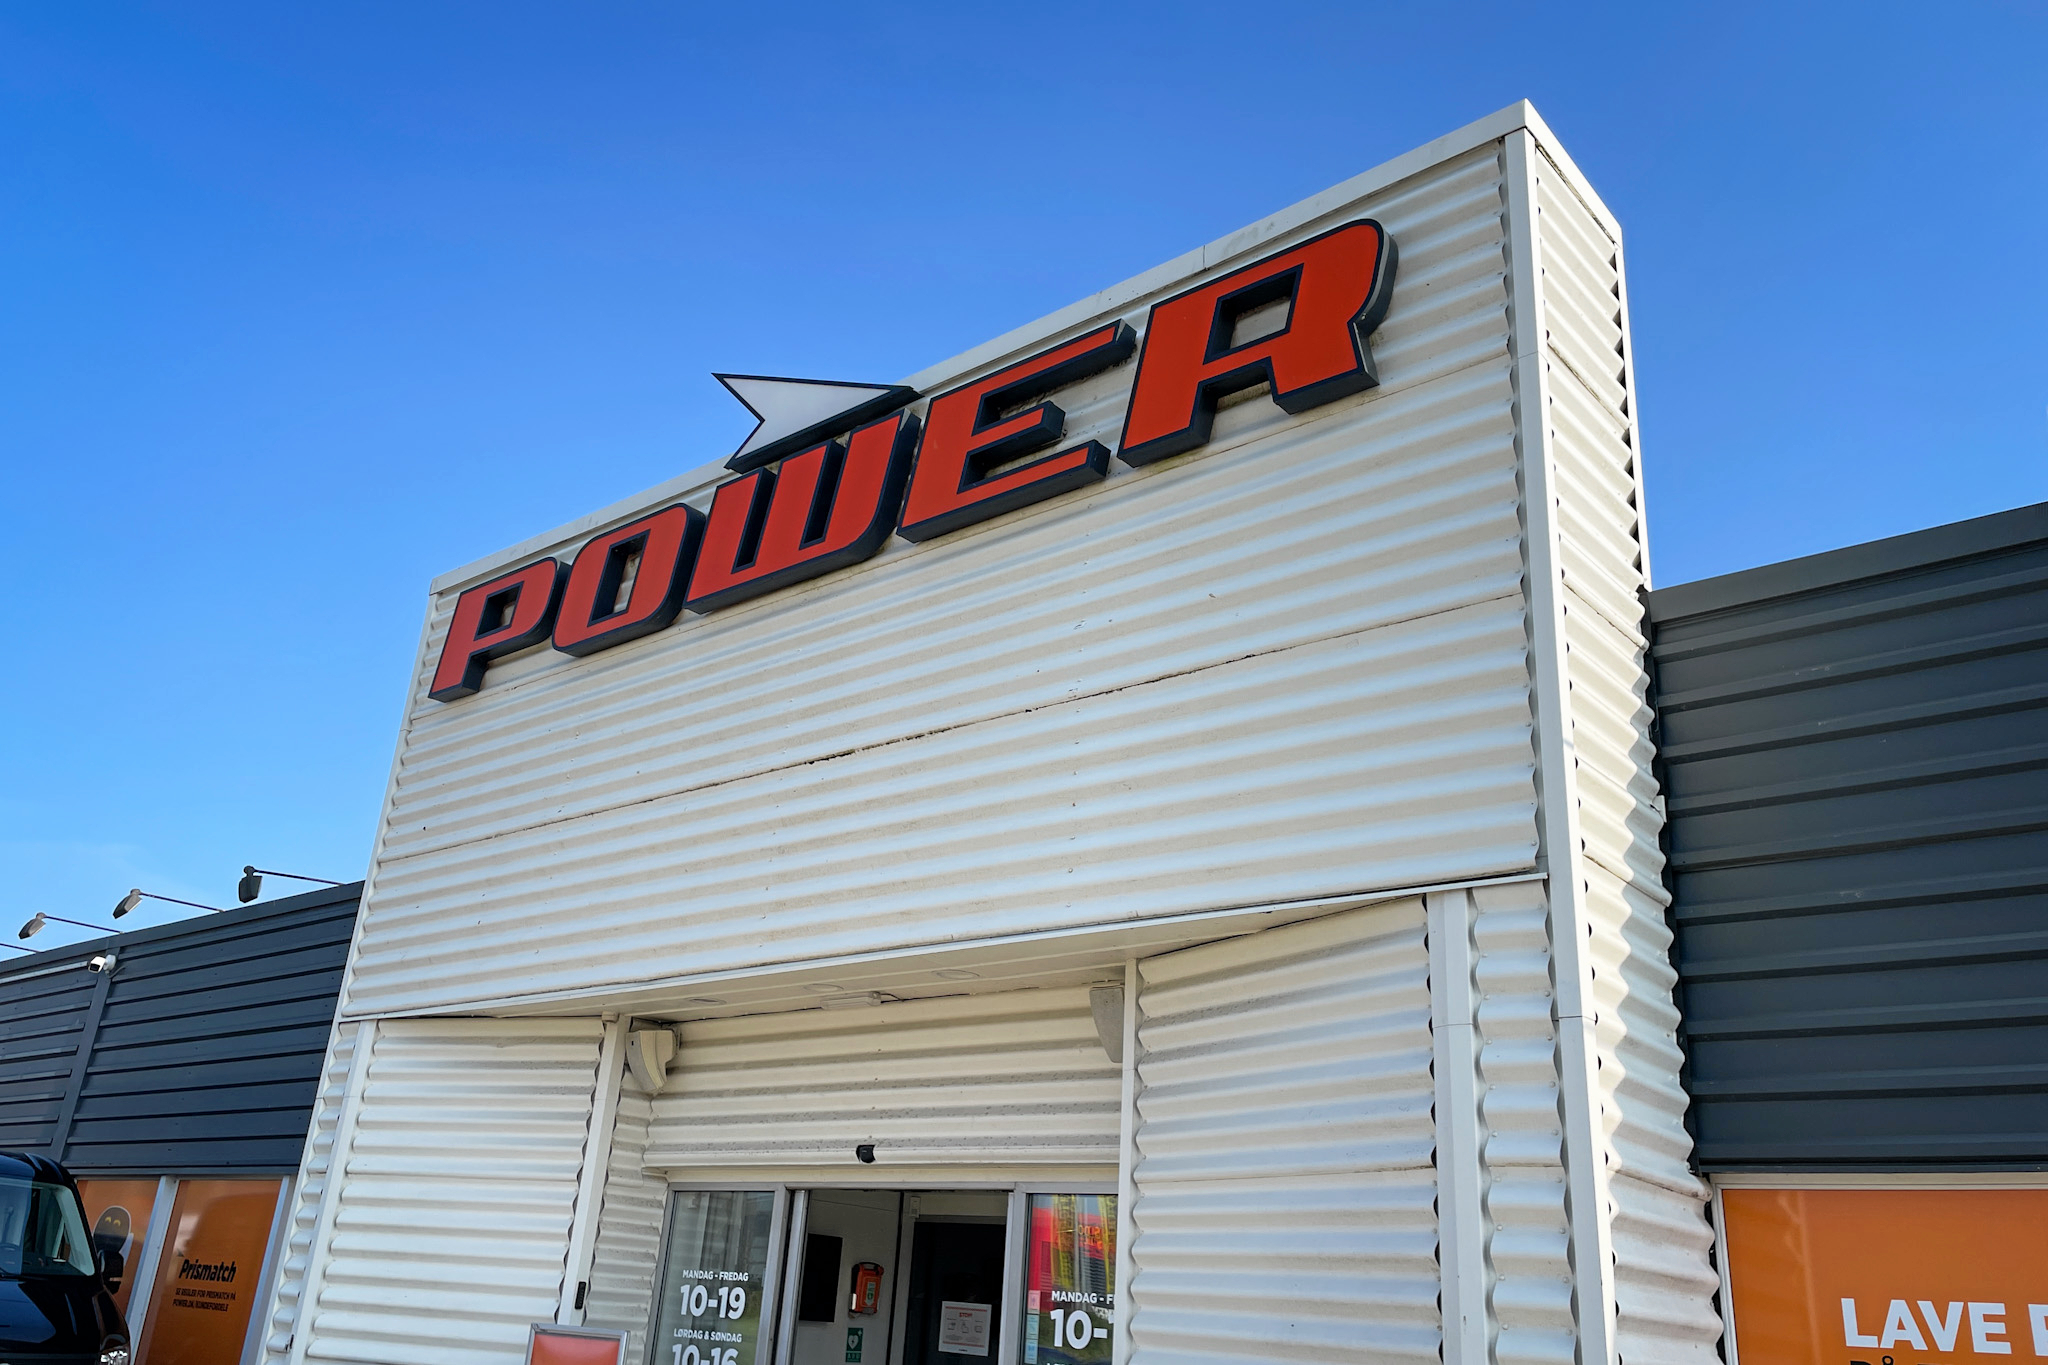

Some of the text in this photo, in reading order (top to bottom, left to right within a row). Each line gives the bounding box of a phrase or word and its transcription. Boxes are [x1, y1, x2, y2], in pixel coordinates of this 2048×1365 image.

[428, 217, 1398, 703] POWER
[179, 1259, 237, 1282] Prismatch
[682, 1269, 714, 1281] MANDAG
[719, 1271, 749, 1281] FREDAG
[680, 1284, 746, 1320] 10-19
[1051, 1290, 1097, 1304] MANDAG
[674, 1328, 742, 1343] LØRDAG & SØNDAG
[1841, 1297, 2012, 1355] LAVE
